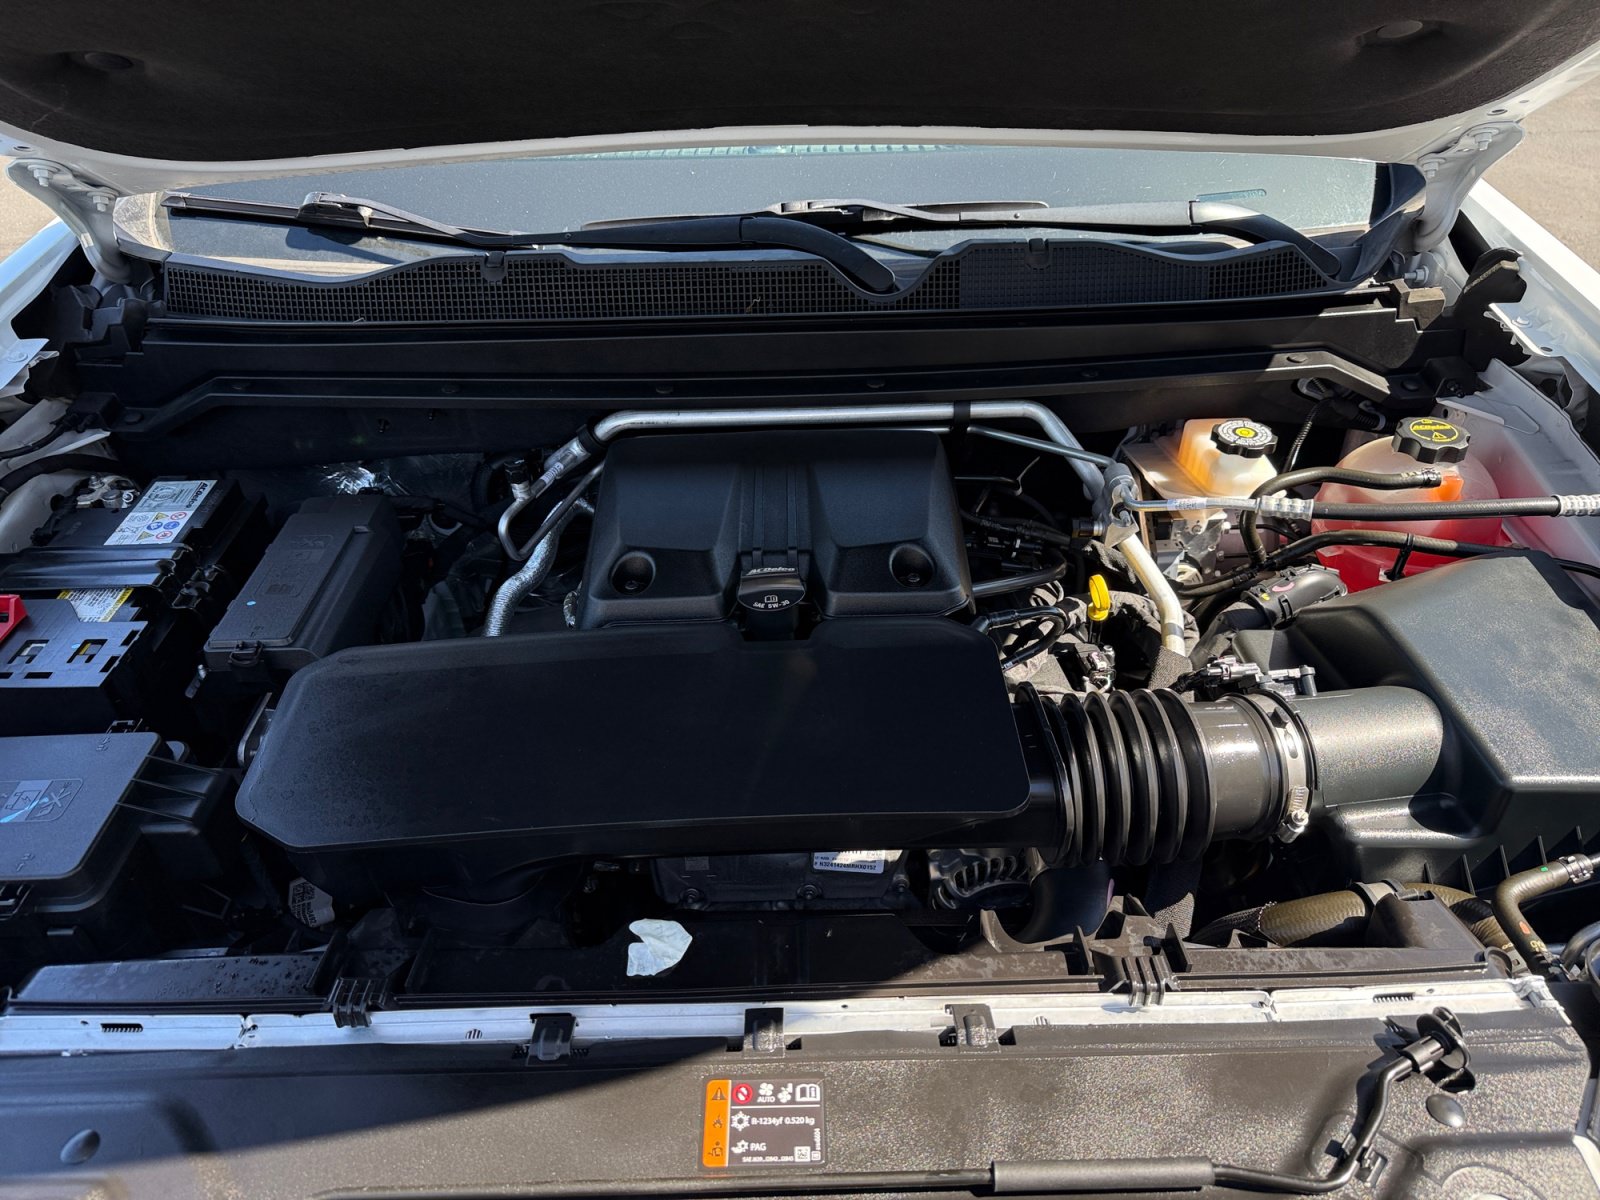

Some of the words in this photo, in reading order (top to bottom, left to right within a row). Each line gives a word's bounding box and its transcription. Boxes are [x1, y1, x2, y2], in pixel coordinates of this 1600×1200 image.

[185, 481, 209, 509] ACDelco
[757, 1095, 776, 1103] AUTO
[784, 1116, 805, 1125] 0.520
[805, 1116, 815, 1126] kg
[749, 1143, 767, 1152] PAG
